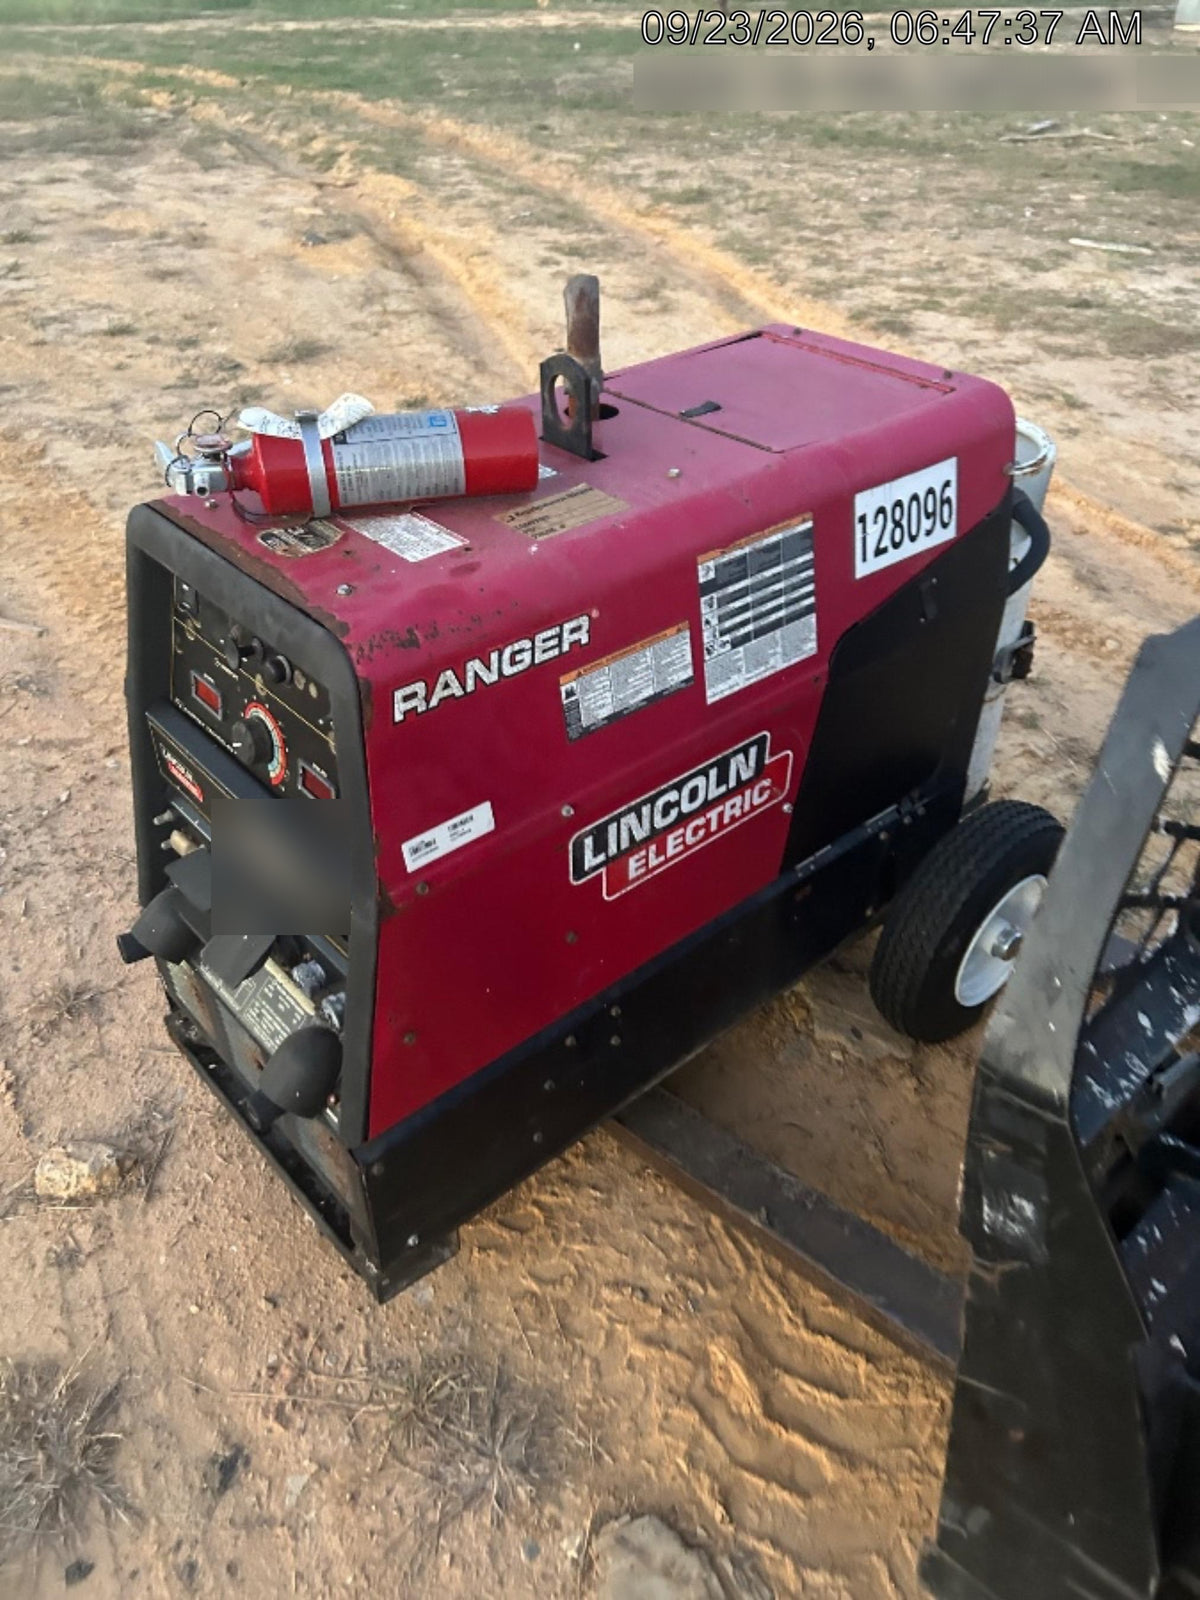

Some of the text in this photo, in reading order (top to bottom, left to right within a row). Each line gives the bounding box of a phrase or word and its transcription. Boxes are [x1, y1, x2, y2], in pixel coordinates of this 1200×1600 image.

[857, 479, 954, 564] 128096
[392, 613, 591, 725] RANGER
[583, 745, 758, 872] LINCOLN
[628, 778, 773, 881] ELECTRIC
